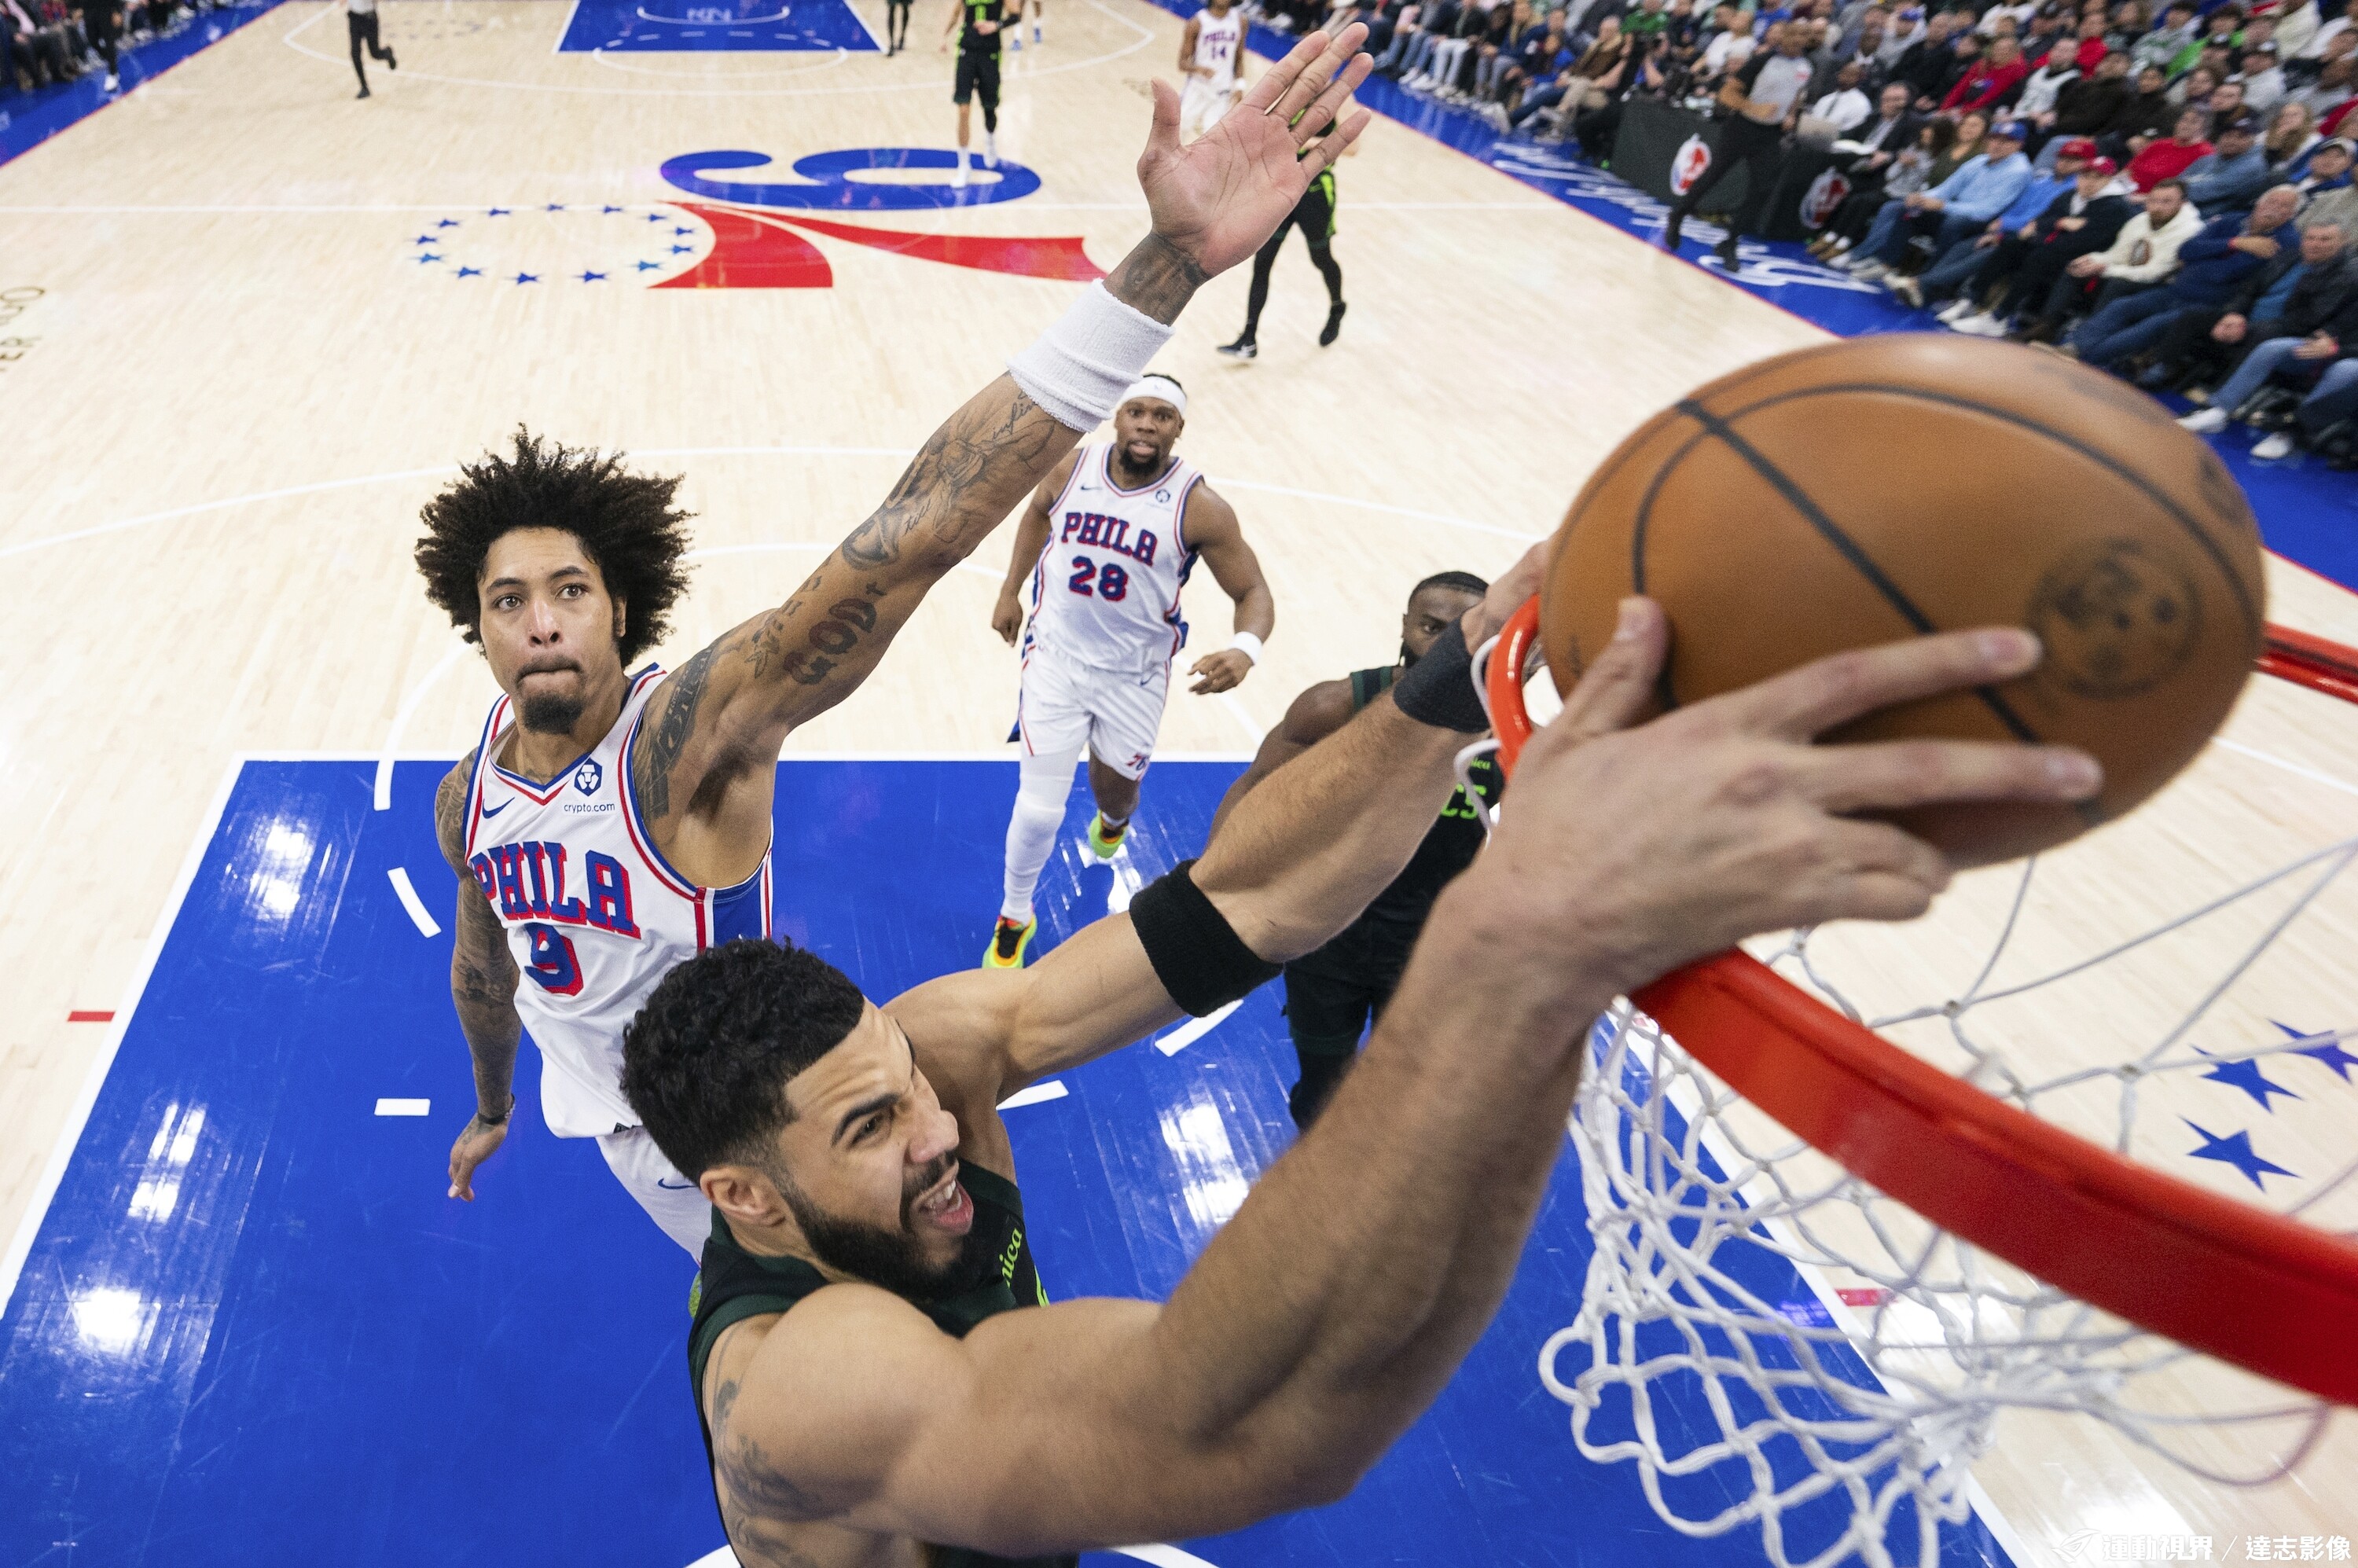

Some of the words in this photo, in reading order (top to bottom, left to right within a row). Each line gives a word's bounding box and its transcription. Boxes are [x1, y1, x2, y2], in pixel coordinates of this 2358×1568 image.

[1203, 31, 1236, 45] PHILA
[1212, 46, 1226, 60] 14
[1060, 512, 1158, 567] PHILA
[1069, 555, 1129, 602] 28
[564, 803, 615, 813] crypto.com
[470, 840, 641, 939] PHILA
[523, 922, 583, 997] 9
